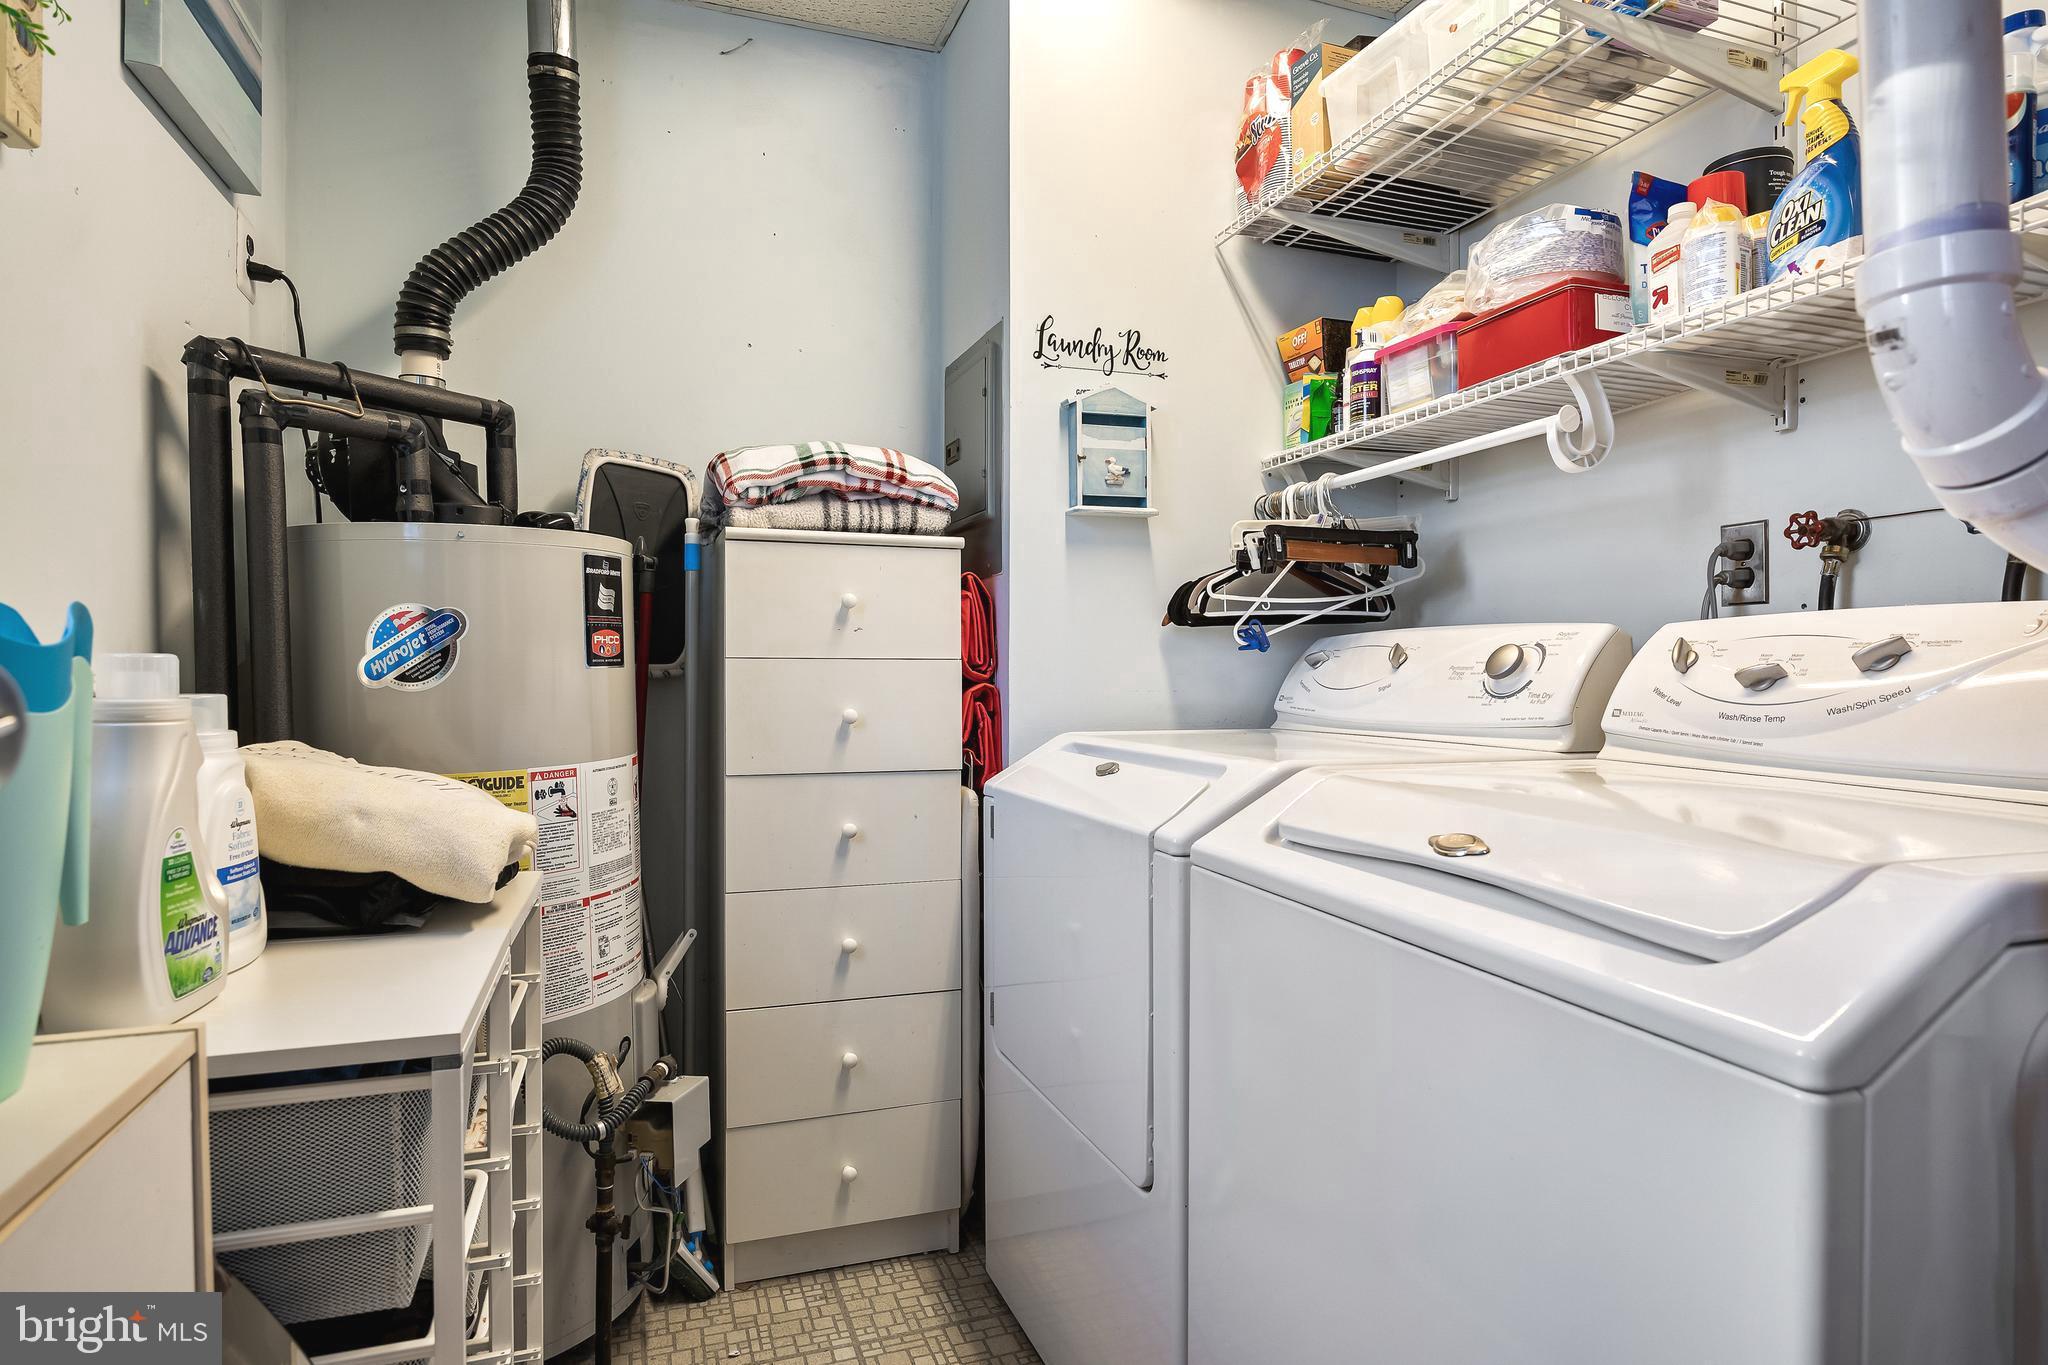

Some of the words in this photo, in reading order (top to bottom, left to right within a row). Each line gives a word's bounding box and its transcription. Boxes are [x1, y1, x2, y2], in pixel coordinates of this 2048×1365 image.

[1292, 59, 1309, 75] Grove
[1781, 191, 1812, 224] OXI
[1771, 199, 1823, 249] CLEAN
[1033, 315, 1121, 376] Laundry
[1118, 329, 1168, 370] Room
[1292, 331, 1307, 347] OFF!
[1288, 357, 1306, 369] TABLETOP
[1350, 383, 1378, 394] STER
[586, 567, 609, 576] BRADFORD
[594, 635, 620, 645] PHCC
[370, 632, 427, 675] Hydrojet
[1378, 682, 1392, 694] Signal
[1652, 686, 1667, 699] Water
[1667, 694, 1682, 707] Level
[1826, 698, 1877, 717] Wash/Spin
[1878, 686, 1912, 705] Speed
[1622, 710, 1644, 718] MAYTAG
[1718, 711, 1761, 723] Wash/Rinse
[1764, 714, 1786, 723] Temp
[544, 770, 575, 780] DANGER
[460, 776, 524, 791] GYGUIDE
[232, 830, 251, 840] Fabric
[229, 853, 240, 861] Free
[164, 915, 219, 957] ADVANCE
